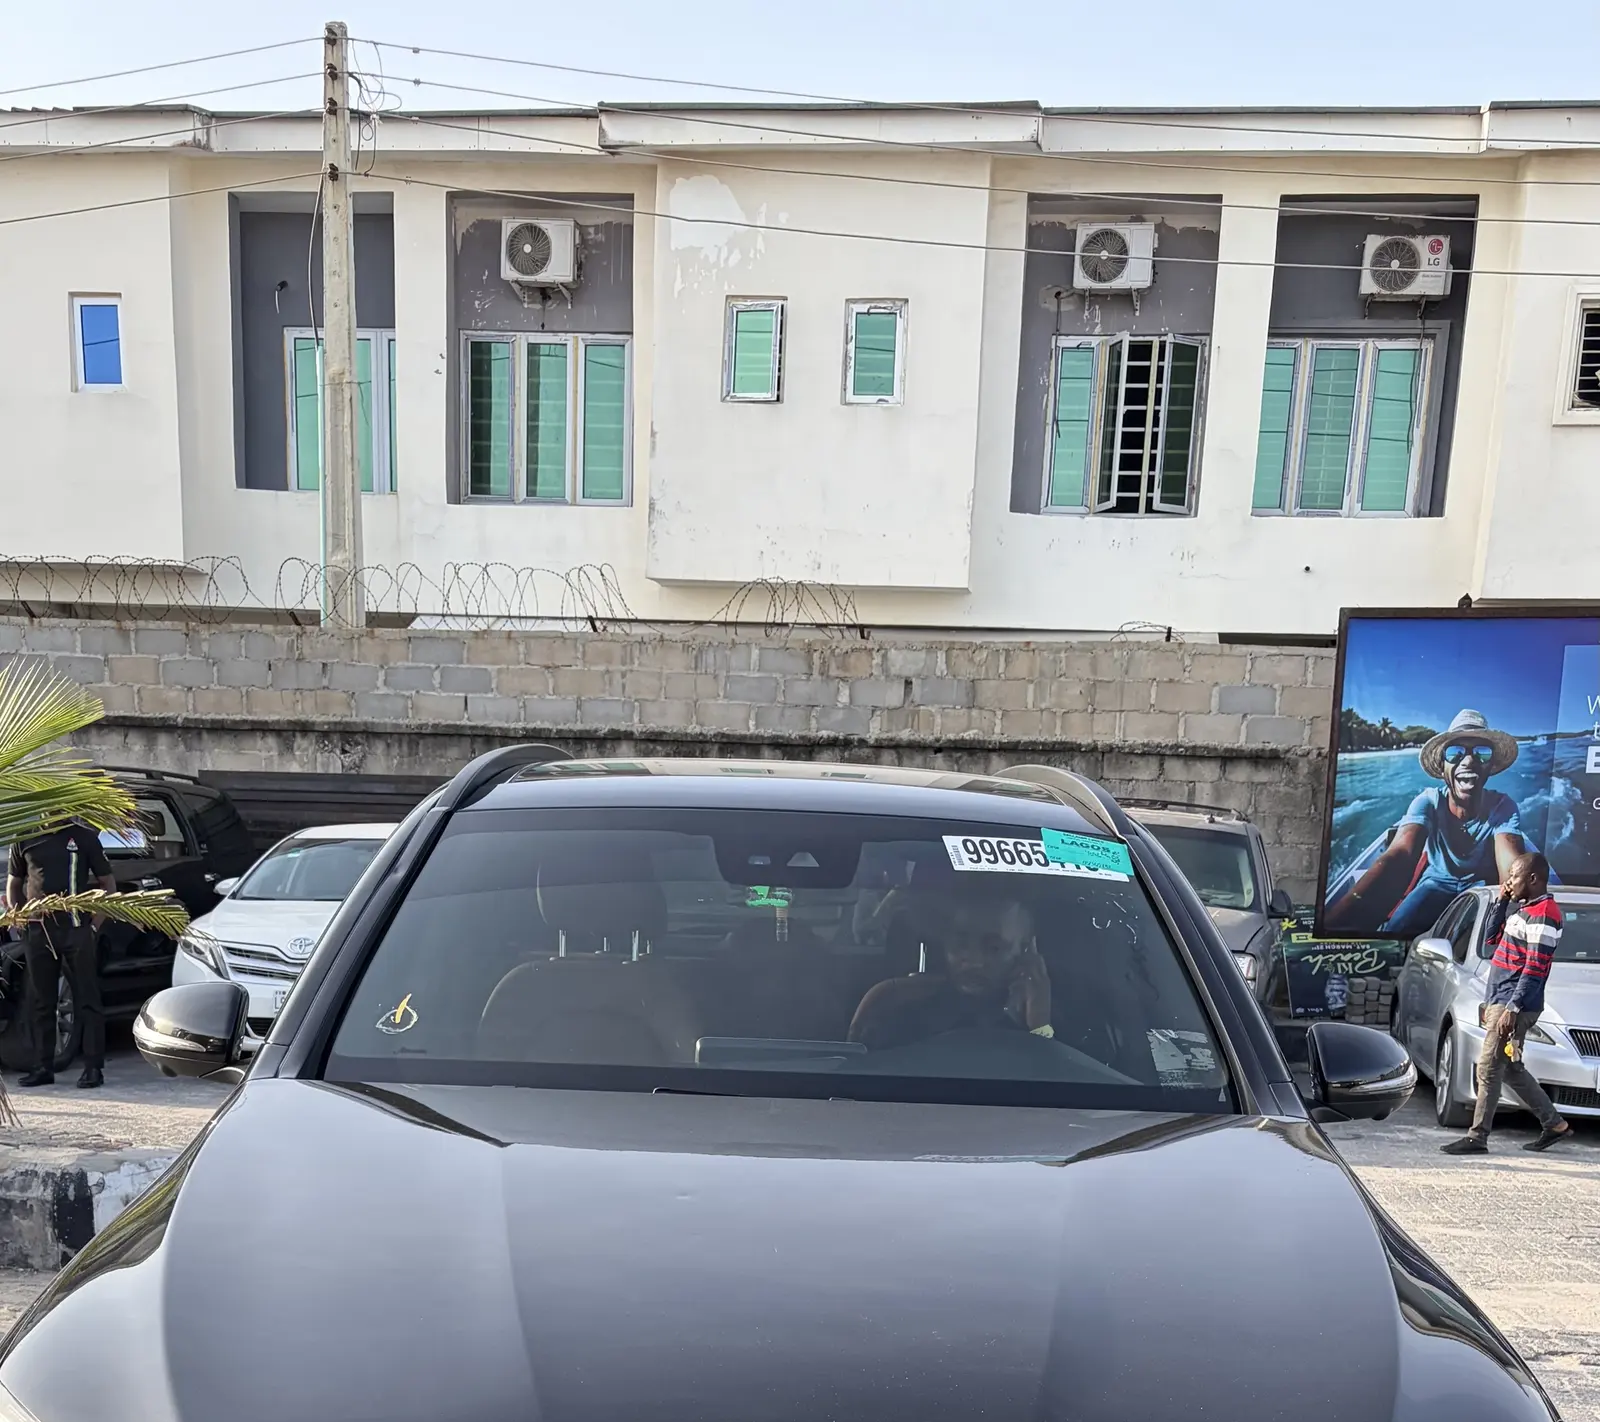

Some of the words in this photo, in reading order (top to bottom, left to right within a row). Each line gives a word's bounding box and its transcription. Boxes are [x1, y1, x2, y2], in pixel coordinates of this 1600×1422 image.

[1427, 257, 1440, 267] LG
[1061, 838, 1111, 853] LAGOS
[1300, 948, 1386, 975] Beach
